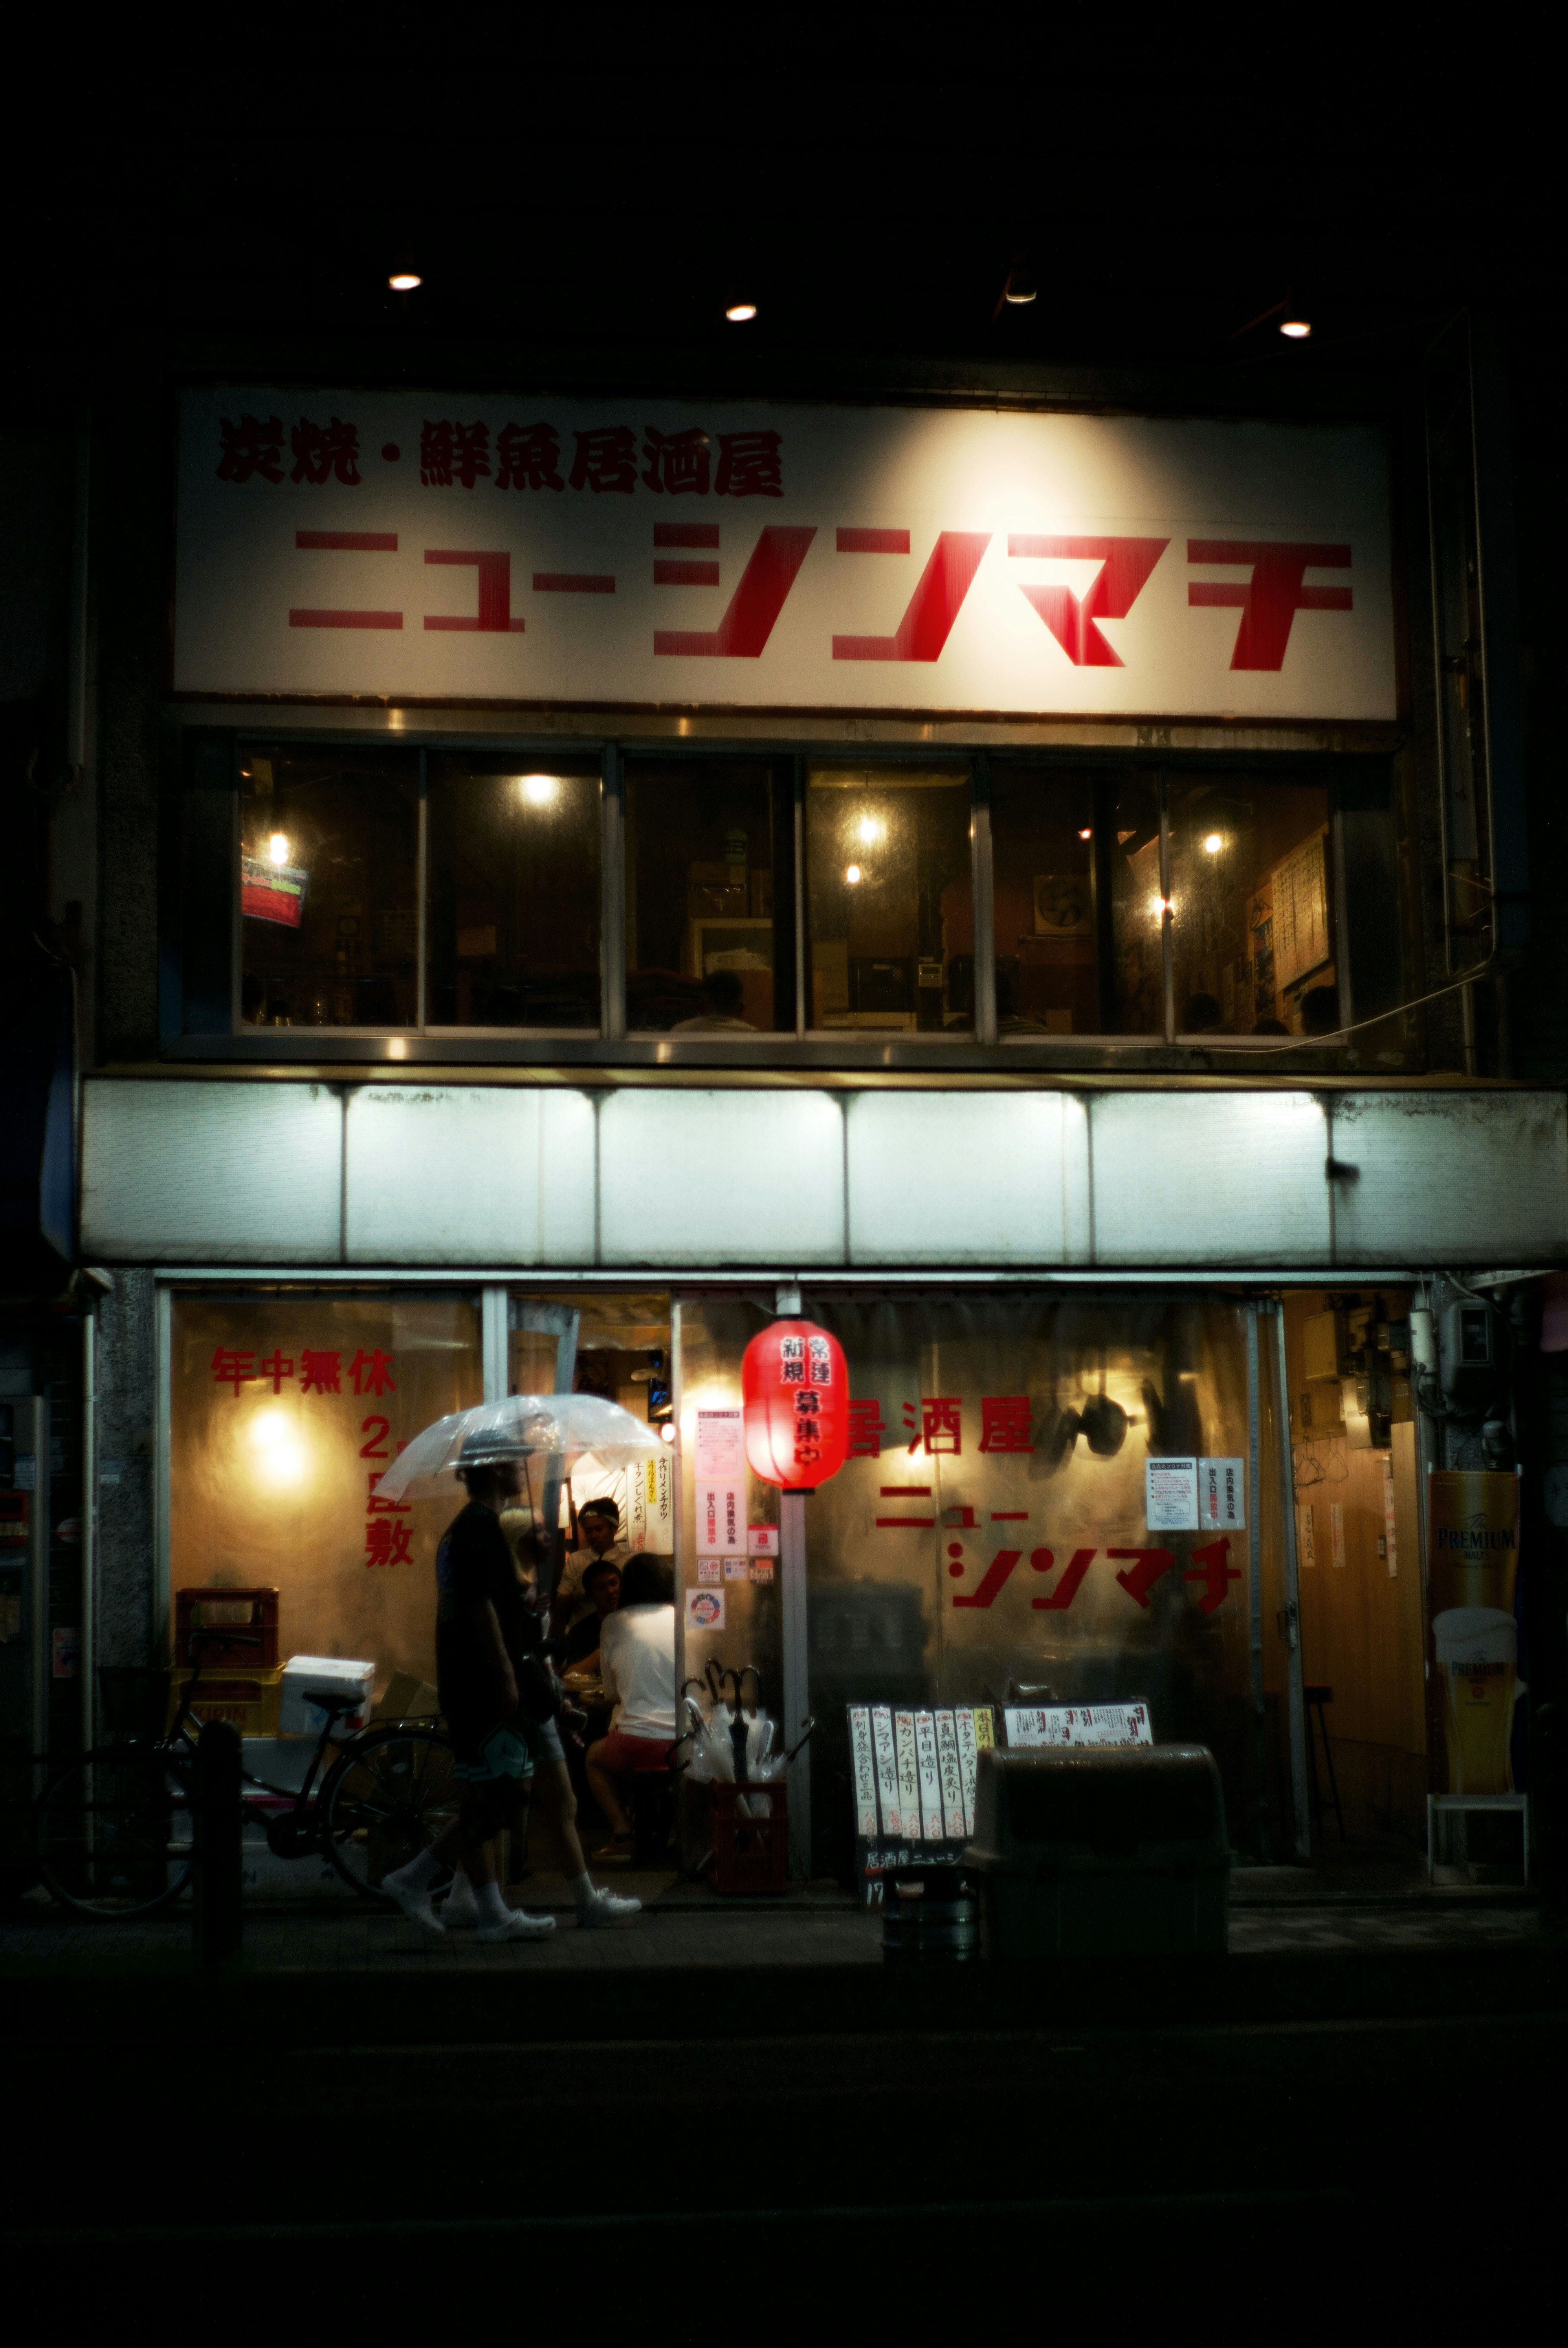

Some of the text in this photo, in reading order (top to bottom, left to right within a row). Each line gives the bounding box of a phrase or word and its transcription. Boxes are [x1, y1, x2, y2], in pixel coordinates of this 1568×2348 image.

[216, 415, 784, 498] 炭焼・鮮魚居酒屋
[289, 523, 1353, 672] ニューシンマチ
[211, 1347, 397, 1398] 年中無休
[794, 1390, 822, 1467] 募集中
[658, 1456, 668, 1520] 手作りメンチカツ
[876, 1486, 1029, 1528] ニュー
[1209, 1468, 1218, 1519] 出入口開放中
[1226, 1468, 1235, 1519] 店内換気の為
[707, 1492, 716, 1545] 出入口開放中
[726, 1492, 736, 1545] 店内換気の為
[1437, 1528, 1516, 1549] PREMIUM
[947, 1537, 1242, 1614] シンマチ
[1452, 1661, 1504, 1676] PREMIUM
[877, 1722, 896, 1793] シマアジ造り
[919, 1726, 936, 1785] 平目造り
[977, 1711, 991, 1748] 本日の
[855, 1721, 873, 1801] 刺身盛合わせ三品
[899, 1728, 916, 1795] カンパチ造り
